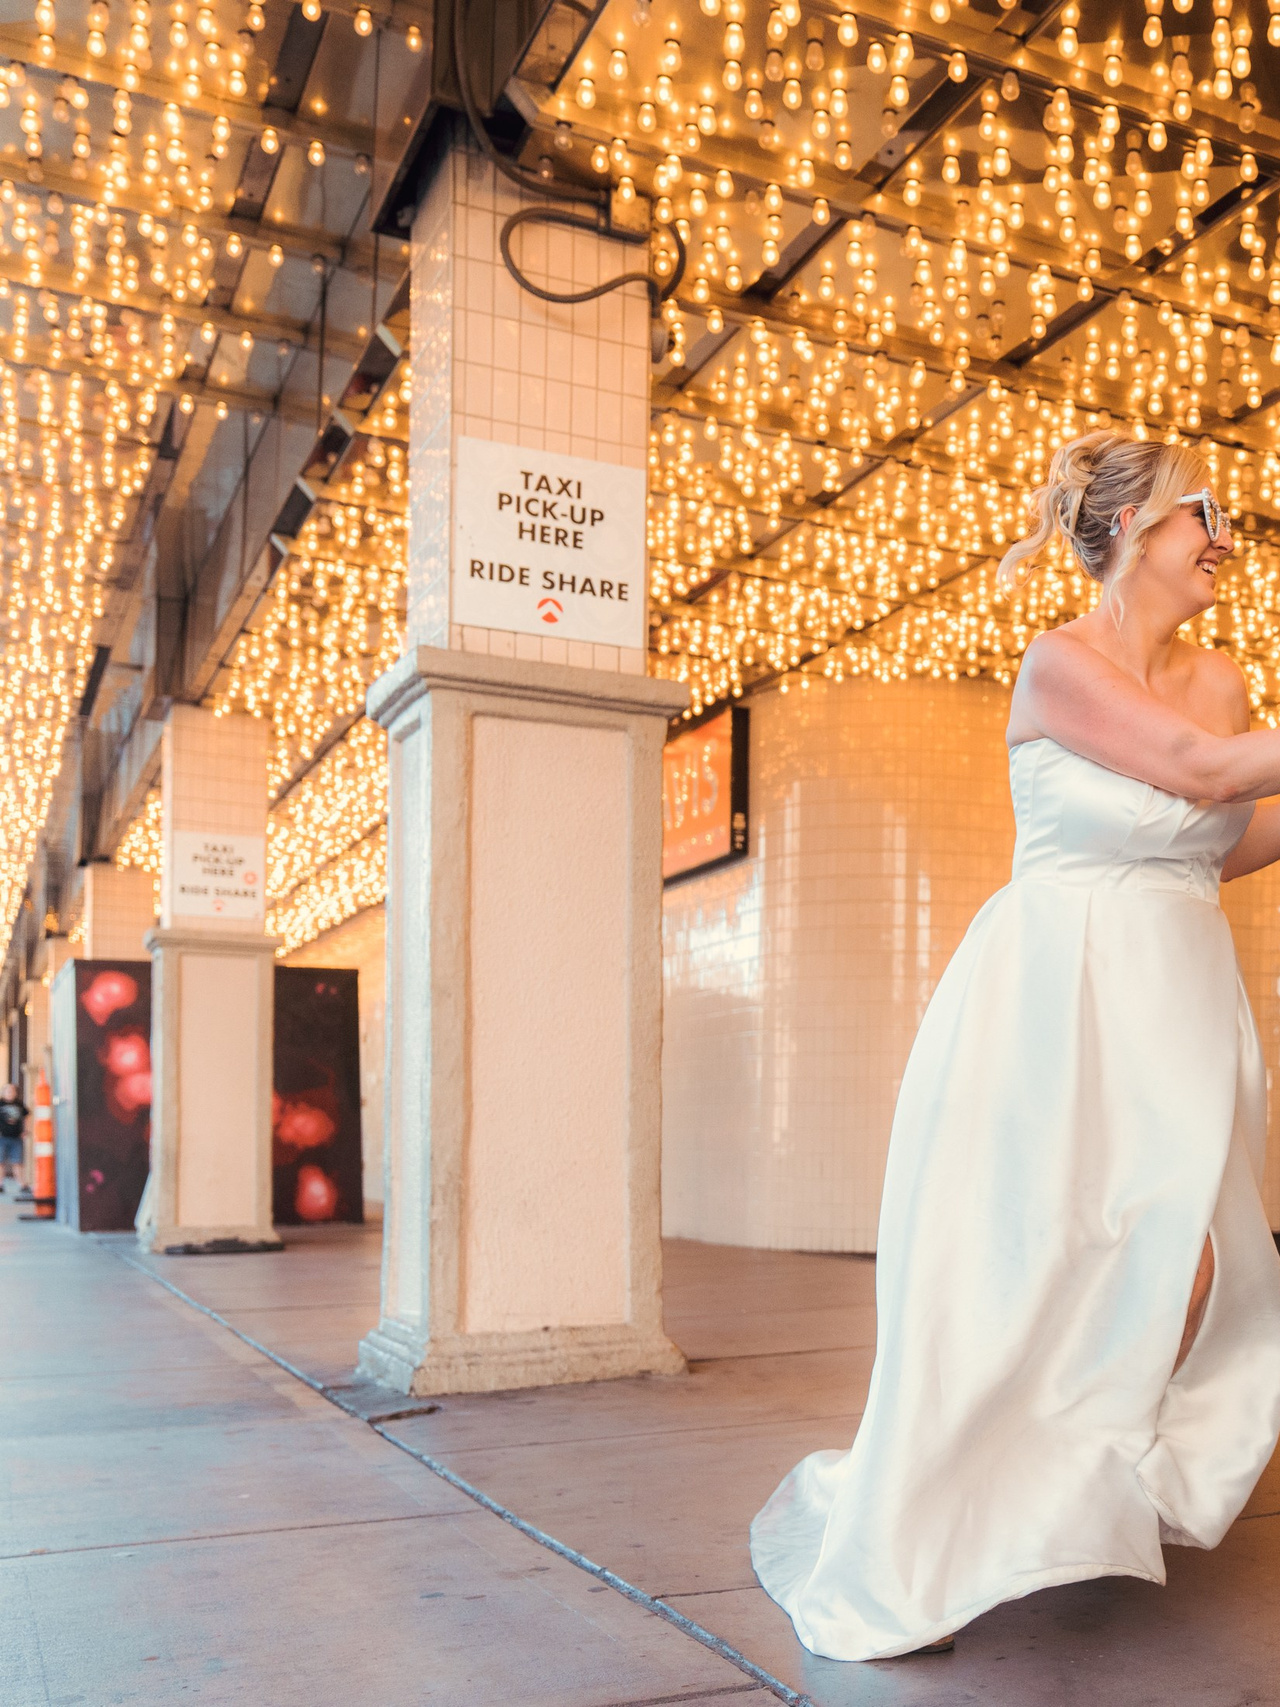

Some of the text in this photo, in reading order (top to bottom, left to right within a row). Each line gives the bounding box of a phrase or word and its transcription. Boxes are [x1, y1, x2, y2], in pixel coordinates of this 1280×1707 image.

[520, 470, 582, 499] TAXI
[498, 492, 605, 527] PICK-UP
[518, 521, 584, 549] HERE
[470, 559, 629, 601] RIDE SHARE
[203, 842, 234, 853] TAXI
[202, 867, 234, 876] HERE
[179, 884, 257, 899] RIDE SHARE
